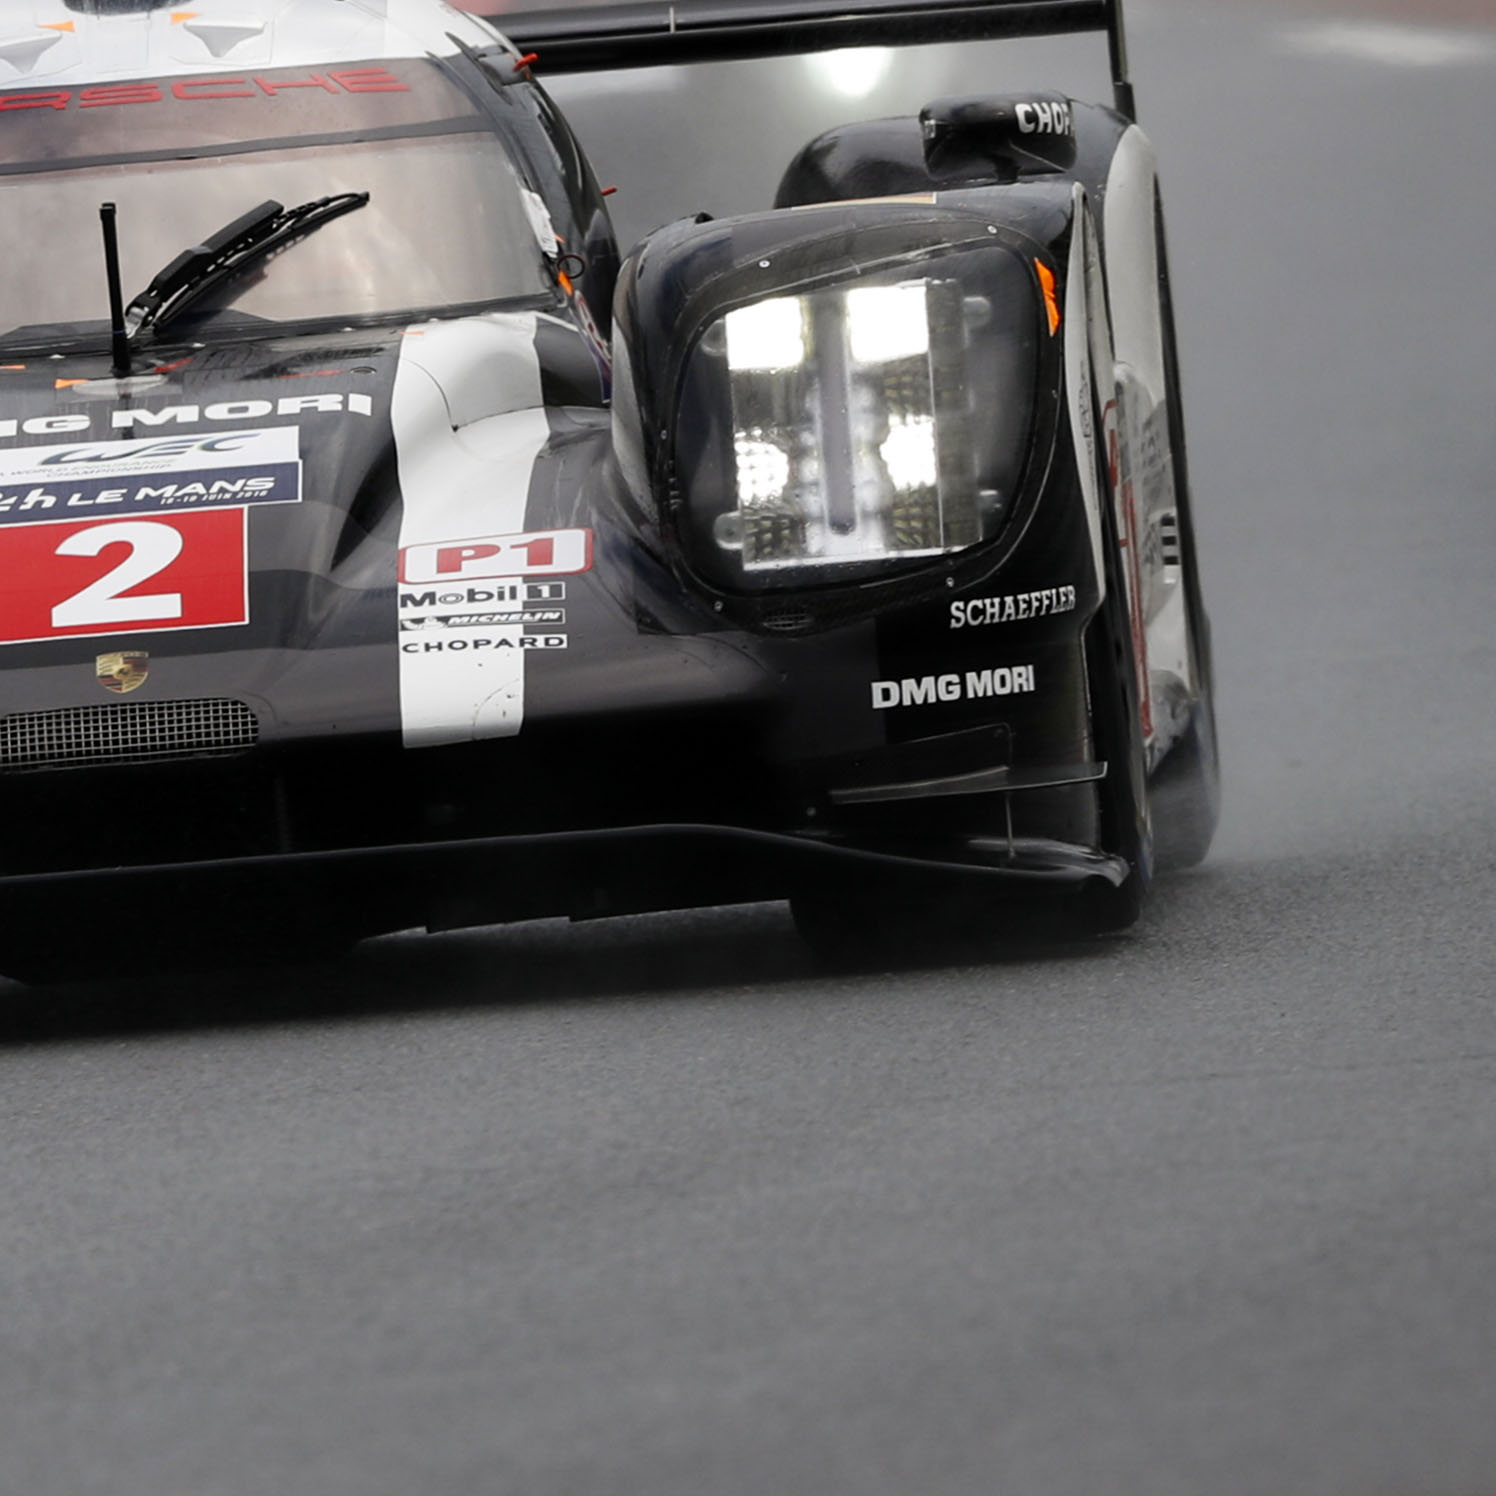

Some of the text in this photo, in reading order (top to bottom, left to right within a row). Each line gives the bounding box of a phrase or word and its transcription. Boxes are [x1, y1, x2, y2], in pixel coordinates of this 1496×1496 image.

[111, 392, 373, 429] MORI
[37, 432, 262, 466] WEC
[67, 488, 129, 507] LE
[134, 476, 276, 501] MANS
[436, 536, 555, 574] P1
[50, 520, 184, 628] 2
[400, 584, 518, 609] Mobil
[949, 584, 1077, 630] SCHAEFFLER
[446, 610, 562, 627] MICHELIN
[401, 636, 566, 654] CHOPARD
[870, 663, 1036, 710] DMG MORI
